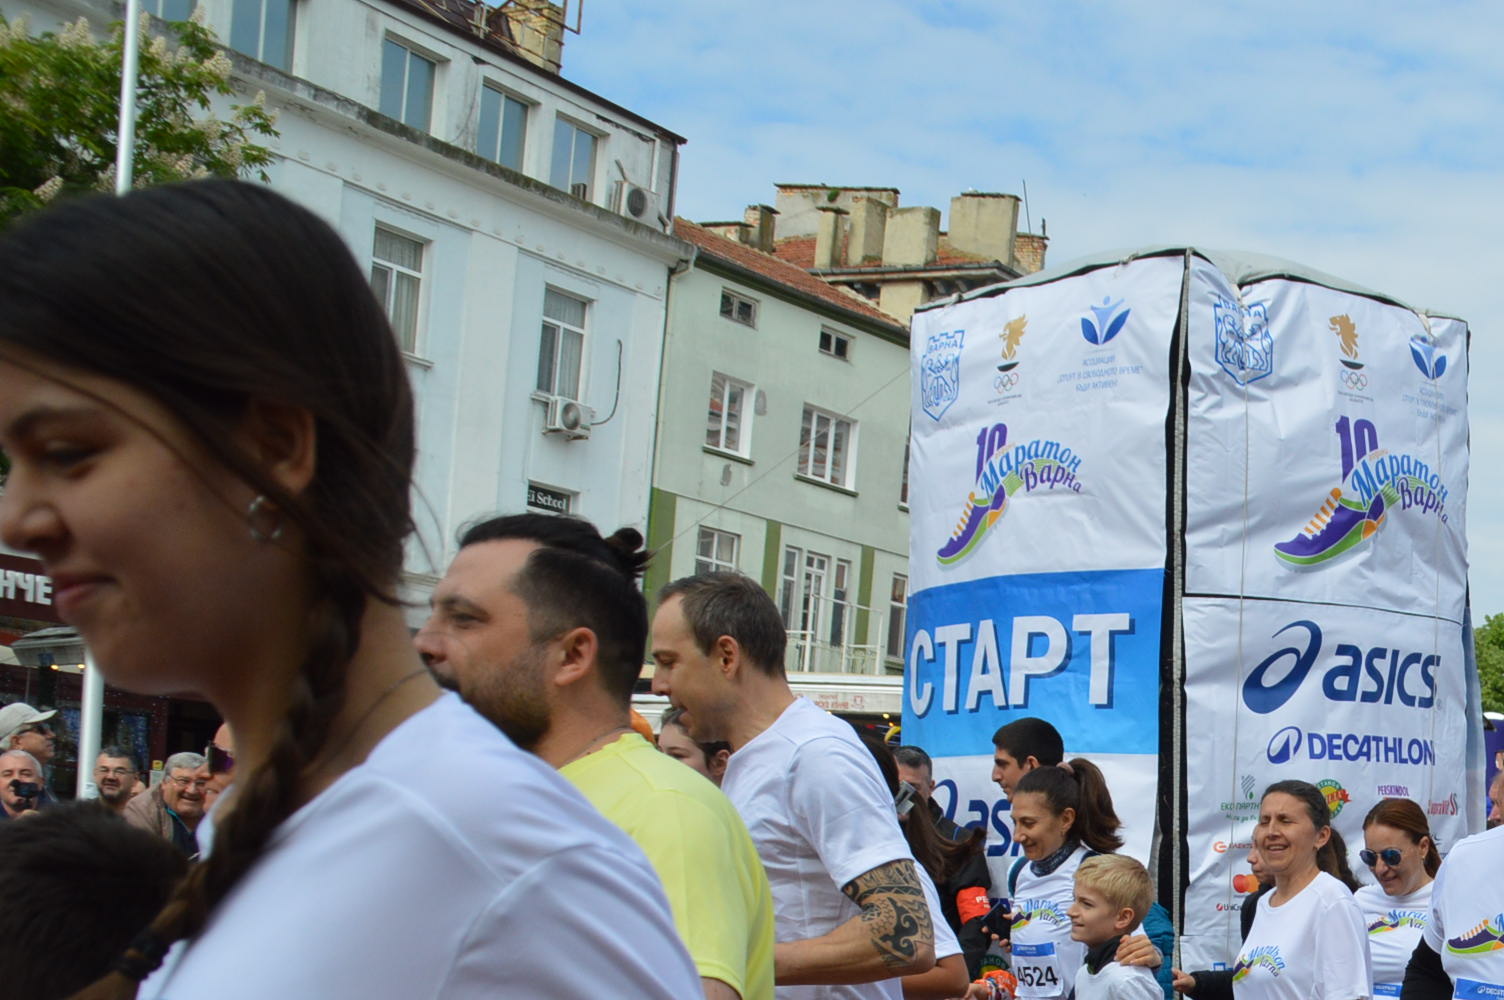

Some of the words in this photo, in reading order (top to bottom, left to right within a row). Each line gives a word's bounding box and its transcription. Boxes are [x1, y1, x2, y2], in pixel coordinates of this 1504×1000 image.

[980, 439, 1083, 500] Маратон
[1020, 461, 1083, 493] Варна
[1351, 453, 1449, 508] Маратон
[1396, 476, 1449, 525] Варна
[909, 612, 1134, 718] СТАРТ
[1322, 643, 1442, 709] asics
[1307, 731, 1437, 767] DECATHLON
[1377, 784, 1410, 798] PERSKINDOL
[1017, 965, 1059, 988] 4524
